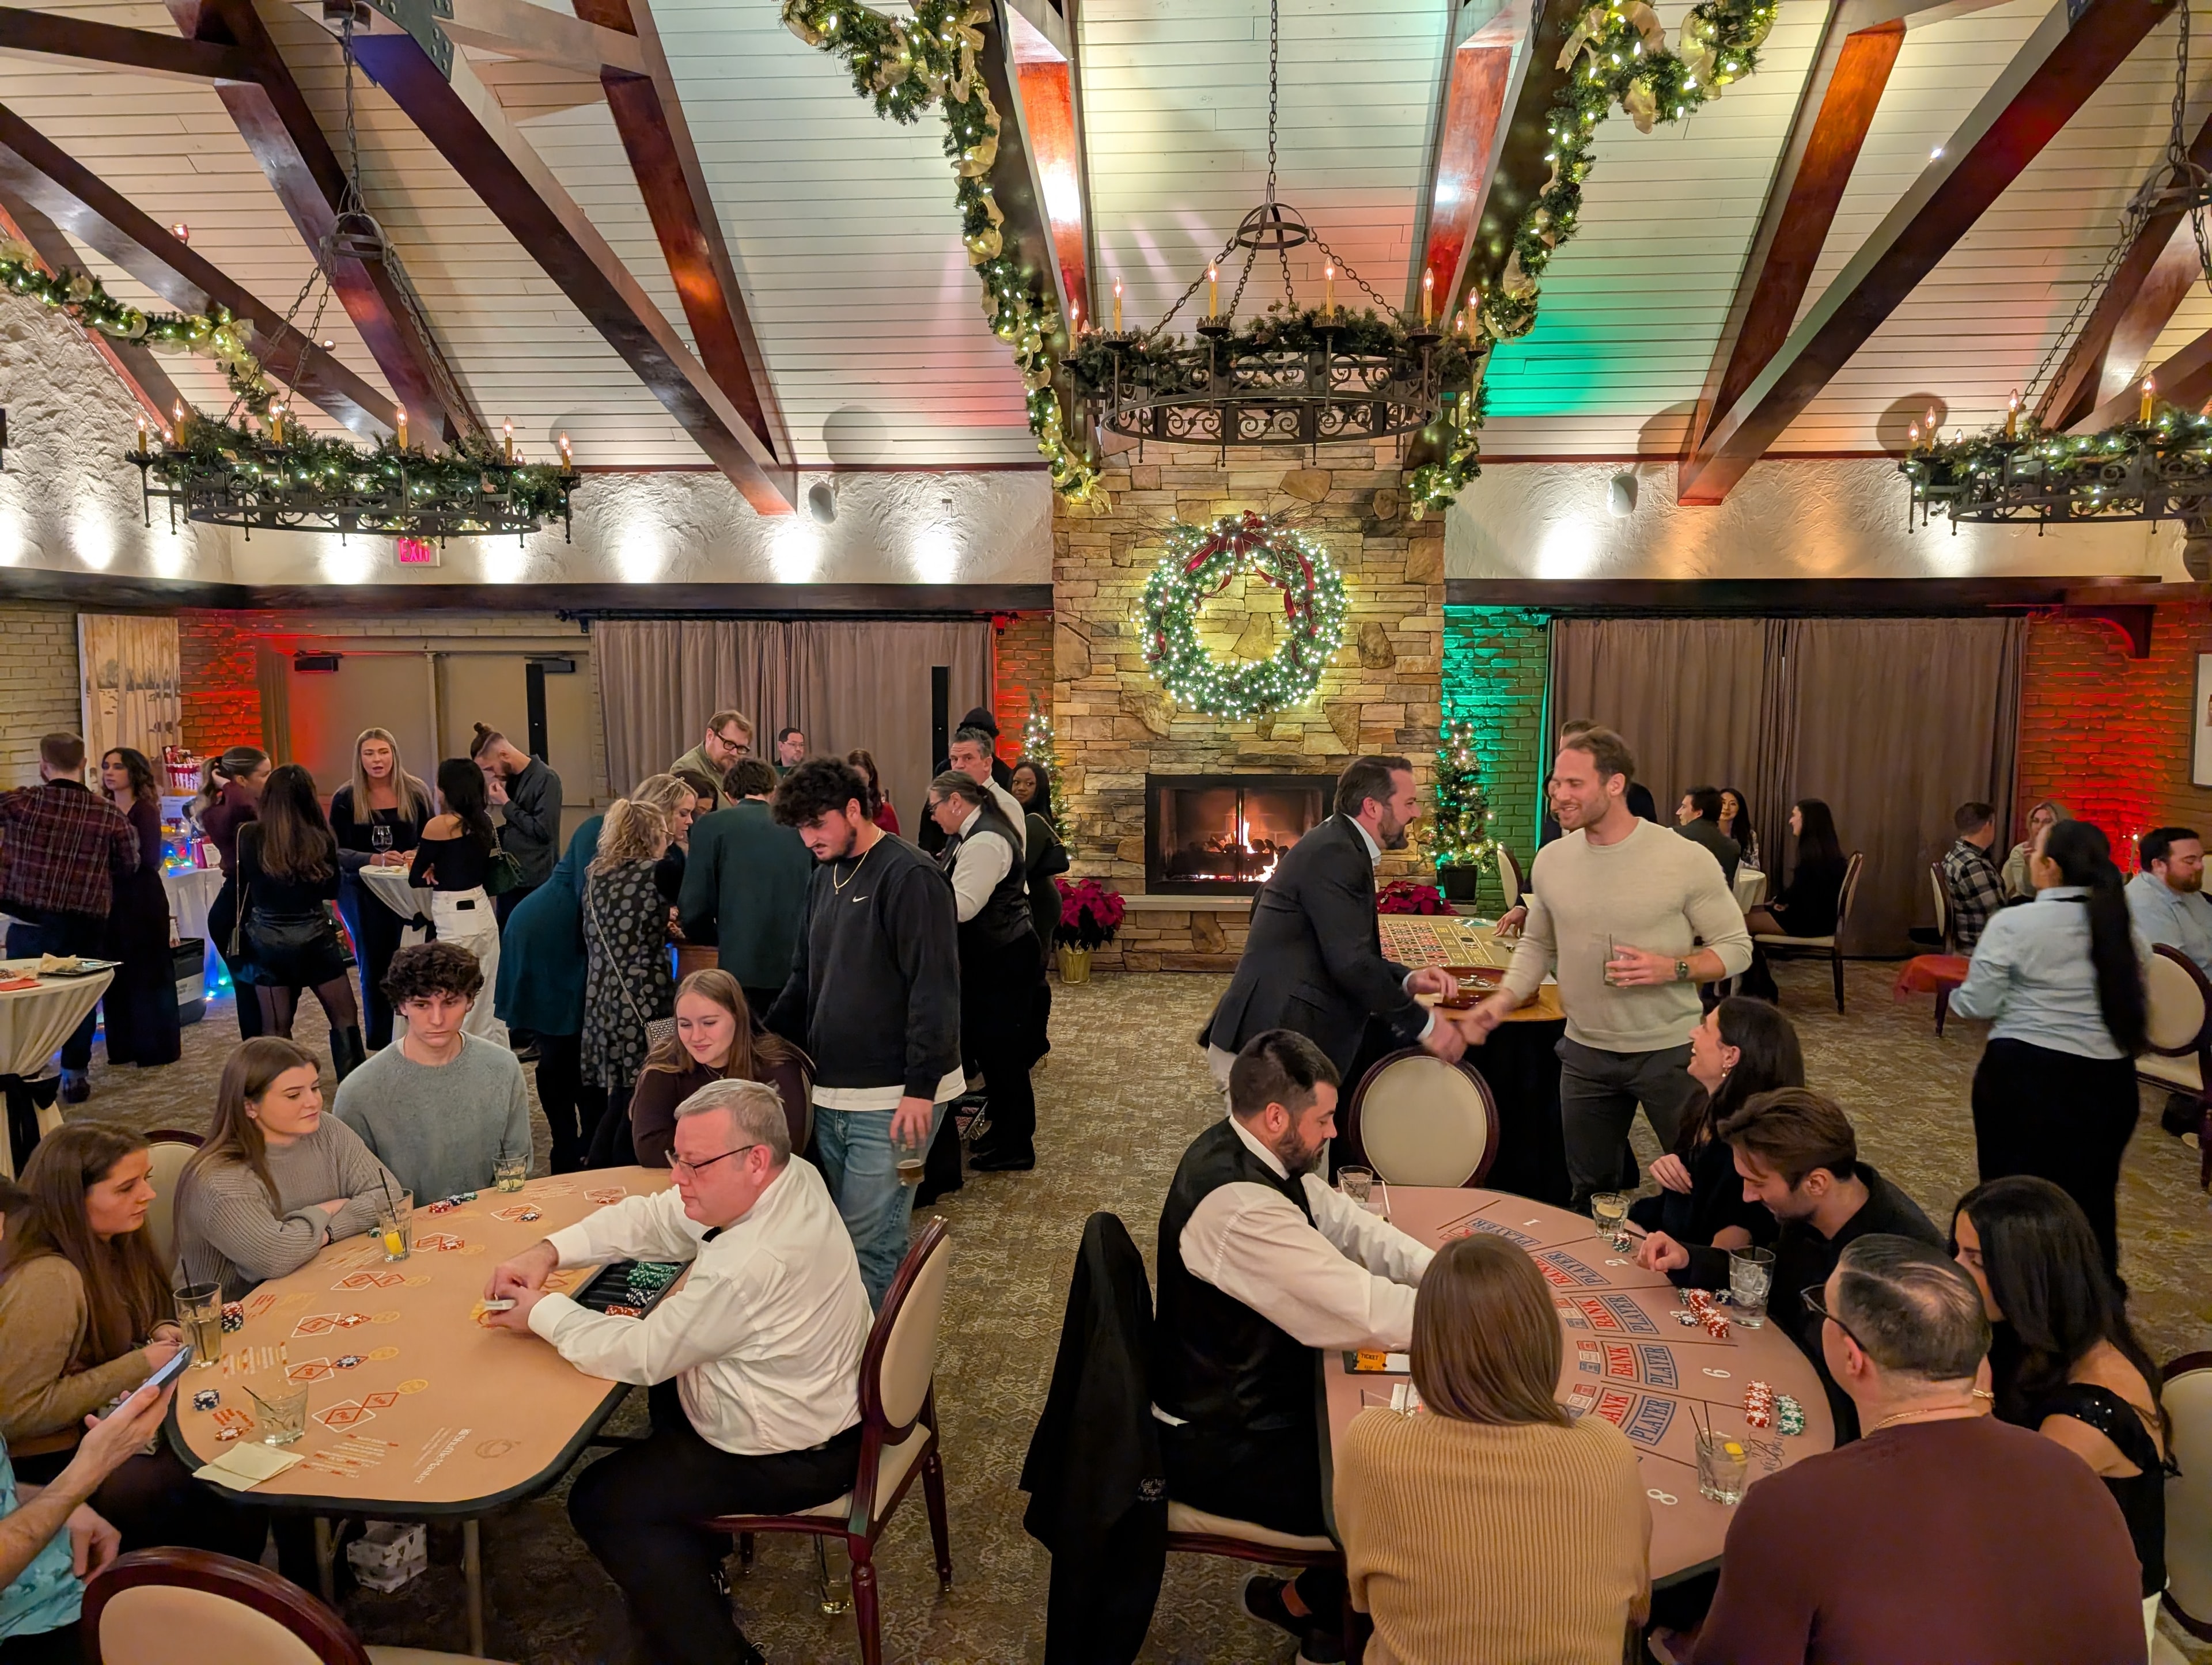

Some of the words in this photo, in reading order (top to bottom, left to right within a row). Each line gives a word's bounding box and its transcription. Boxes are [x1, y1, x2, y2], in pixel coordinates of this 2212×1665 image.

[1473, 1219, 1535, 1247] PLAYER
[1522, 1218, 1541, 1227] 1
[1548, 1251, 1605, 1285] PLAYER
[1605, 1258, 1629, 1267] 2
[1578, 1299, 1617, 1328] BANK
[1608, 1296, 1654, 1332] PLAYER
[1607, 1345, 1634, 1378] BANK
[1643, 1345, 1673, 1386] PLAYER
[1702, 1368, 1731, 1378] 6
[1629, 1398, 1671, 1442] PLAYER
[1646, 1488, 1678, 1505] 8
